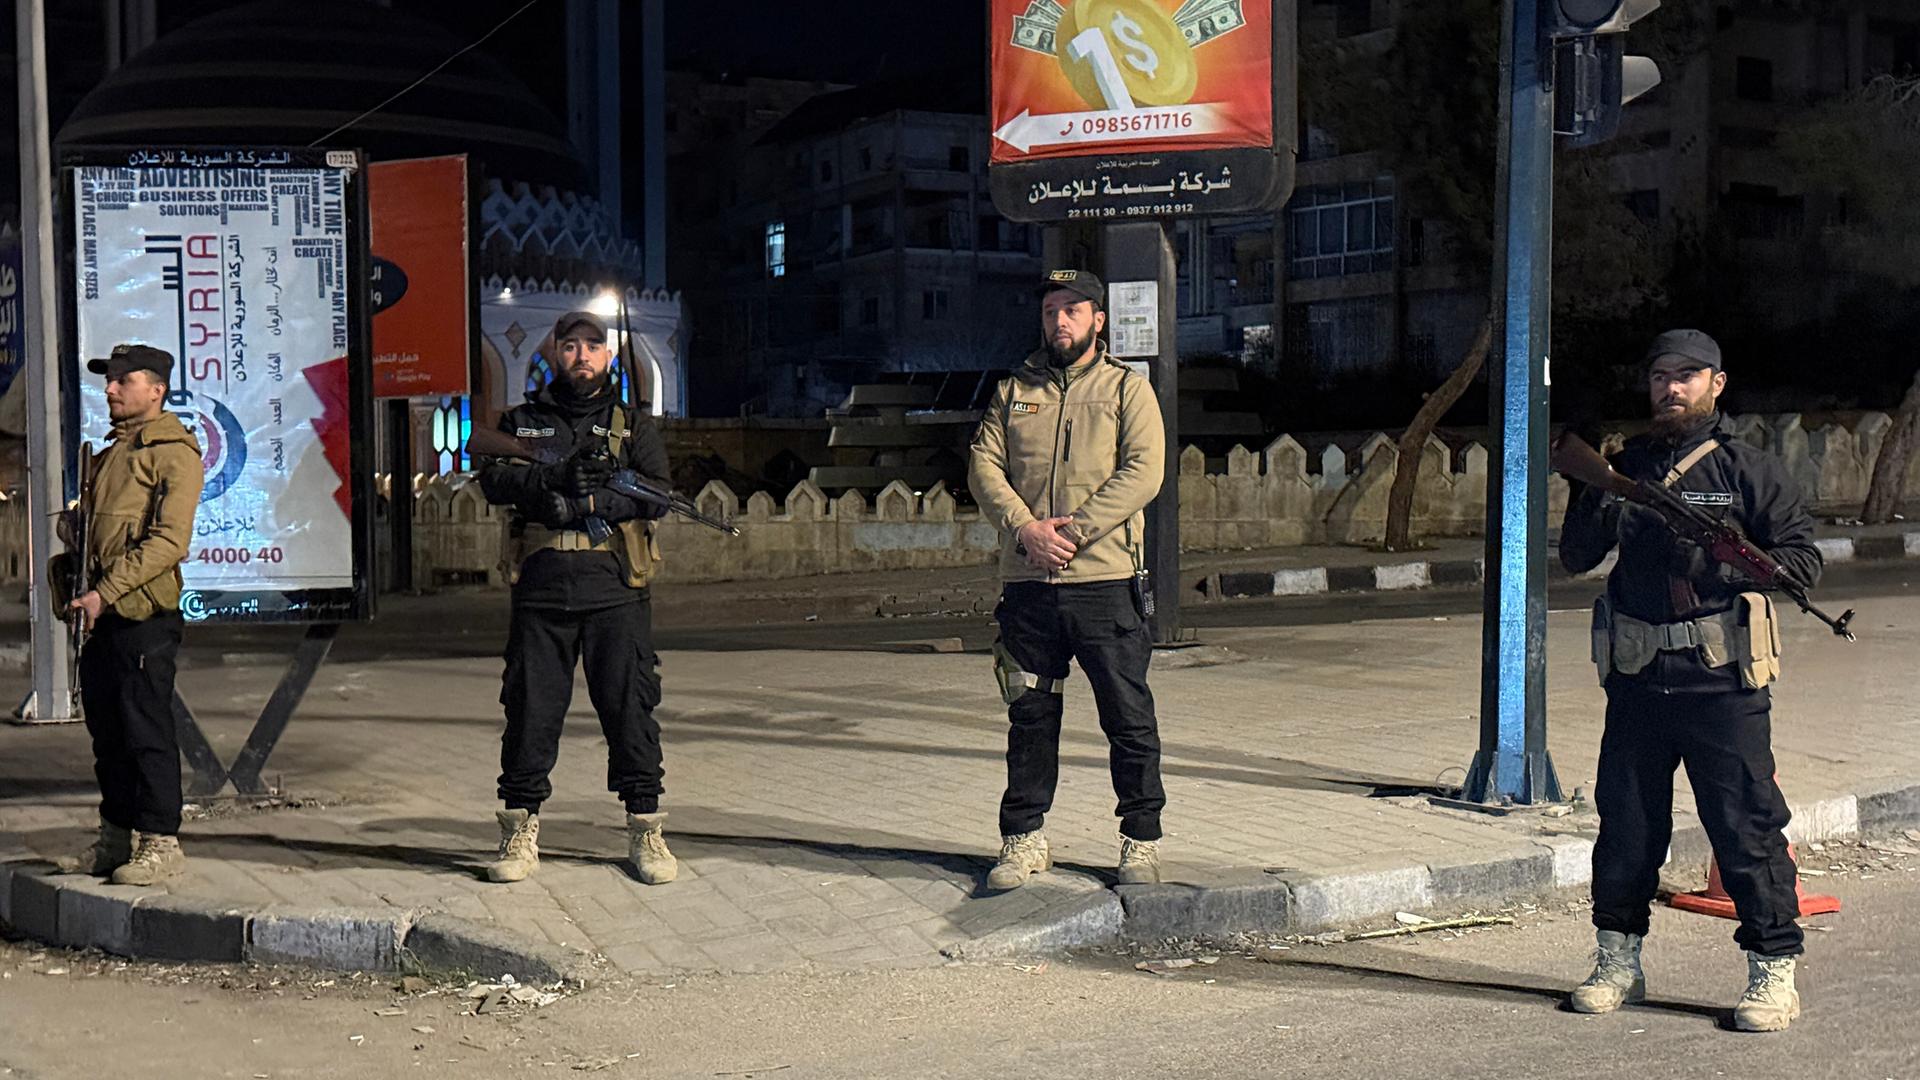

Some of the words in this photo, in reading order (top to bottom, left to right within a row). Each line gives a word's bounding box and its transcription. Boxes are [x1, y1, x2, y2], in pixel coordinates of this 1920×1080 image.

[1110, 10, 1159, 79] $
[1082, 111, 1193, 135] 0985671716
[128, 150, 175, 167] للإعلان
[180, 151, 232, 167] السورية
[237, 151, 291, 167] الشركة
[139, 168, 267, 188] ADVERTISING
[323, 169, 341, 196] ANY
[1101, 175, 1176, 198] بسمة
[1178, 166, 1232, 194] شركة
[96, 191, 136, 203] CHOICE
[139, 190, 217, 202] BUSINESS
[221, 189, 268, 202] OFFERS
[271, 185, 310, 195] CREATE
[1028, 181, 1097, 204] للإعلان
[159, 204, 220, 216] SOLUTIONS
[228, 203, 269, 211] MARKETING
[324, 199, 342, 235] TIME
[1068, 209, 1080, 218] 22
[1082, 208, 1100, 217] 111
[1103, 207, 1116, 216] 30
[1126, 206, 1151, 216] 0937
[1153, 205, 1173, 214] 912
[1174, 204, 1194, 213] 912
[82, 205, 97, 237] PLACE
[83, 239, 98, 270] MANY
[228, 234, 245, 278] الشركة
[295, 247, 334, 258] CREATE
[85, 271, 99, 299] SIZES
[186, 235, 223, 381] SYRIA
[229, 282, 246, 330] السورية
[332, 291, 345, 313] ANY
[332, 316, 346, 349] PLACE
[231, 334, 247, 382] للإعلان
[270, 398, 283, 426] العدد
[197, 547, 251, 564] 4000
[257, 546, 283, 563] 40
